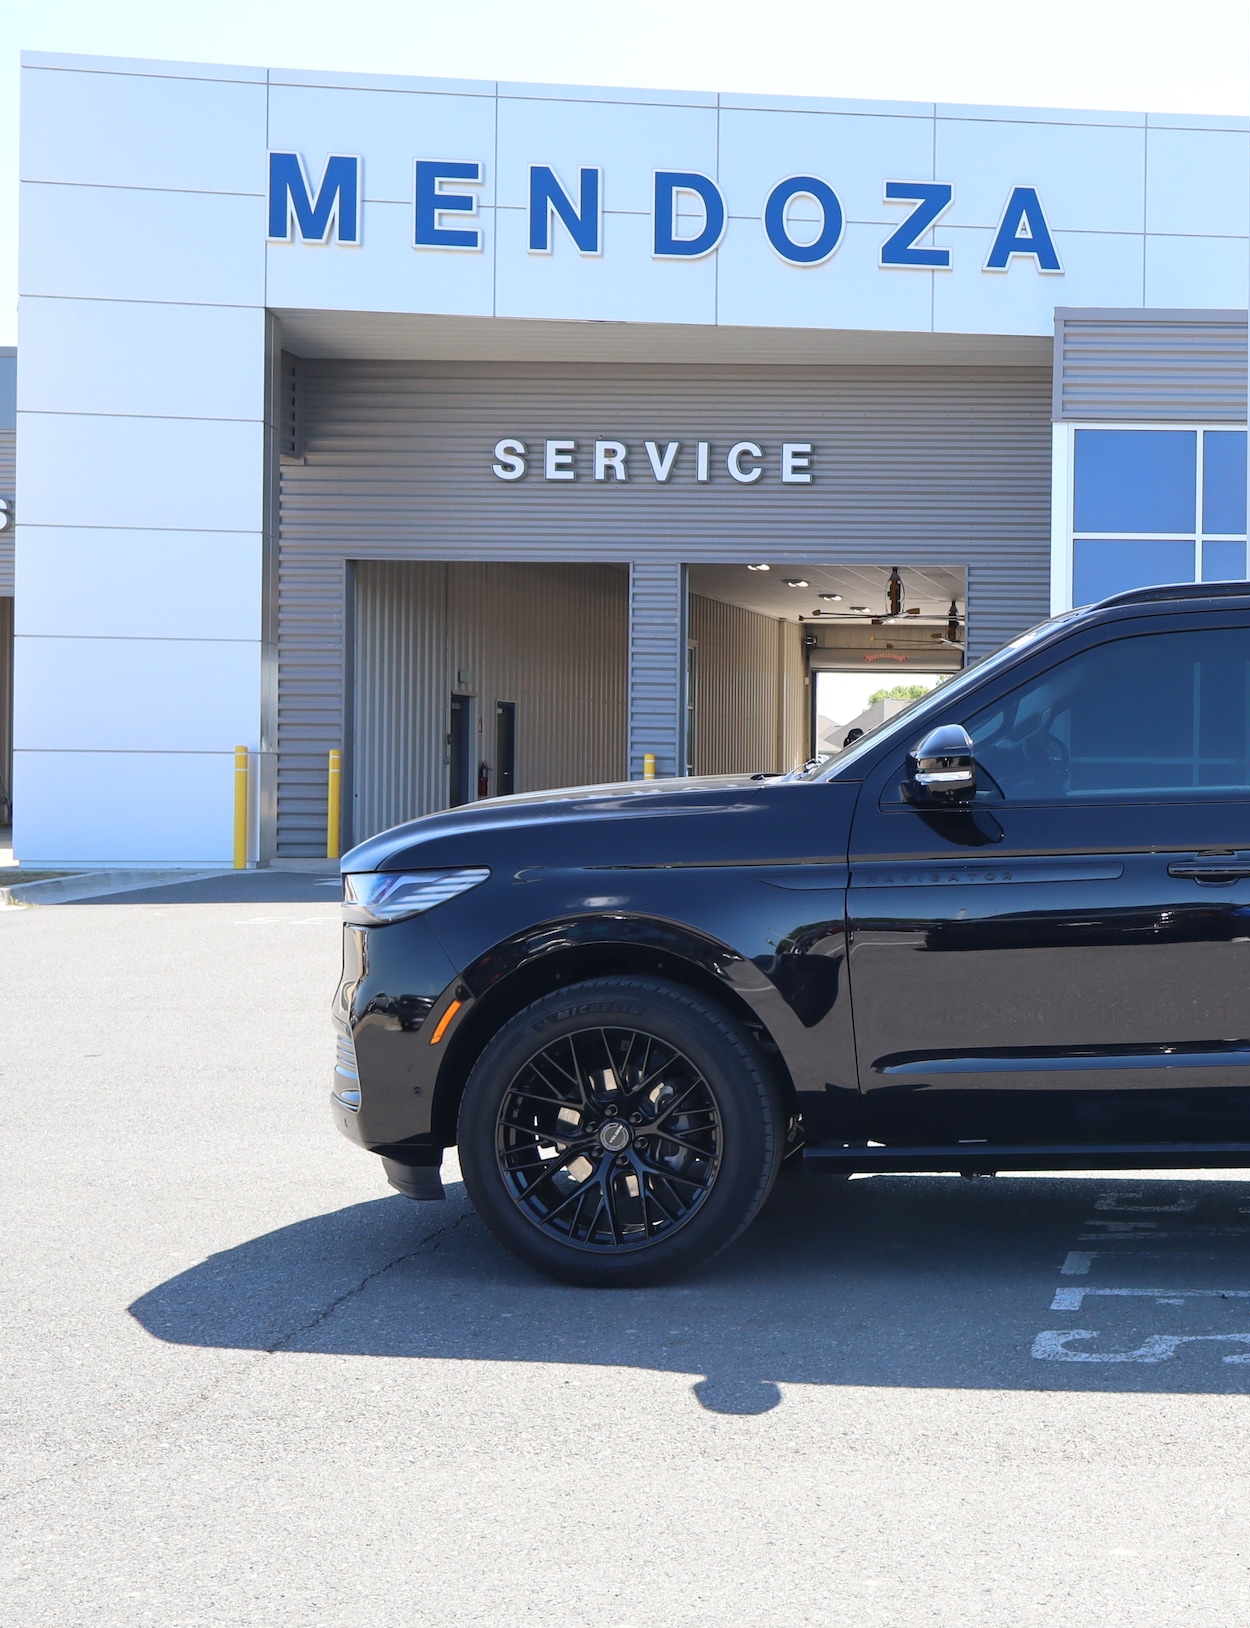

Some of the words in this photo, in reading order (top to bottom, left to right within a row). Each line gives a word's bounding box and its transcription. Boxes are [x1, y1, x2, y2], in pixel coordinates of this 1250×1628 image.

[267, 150, 1064, 273] MENDOZA
[491, 438, 813, 484] SERVICE
[866, 872, 1013, 884] NAVIGATOR
[557, 1003, 641, 1021] MICHELIN
